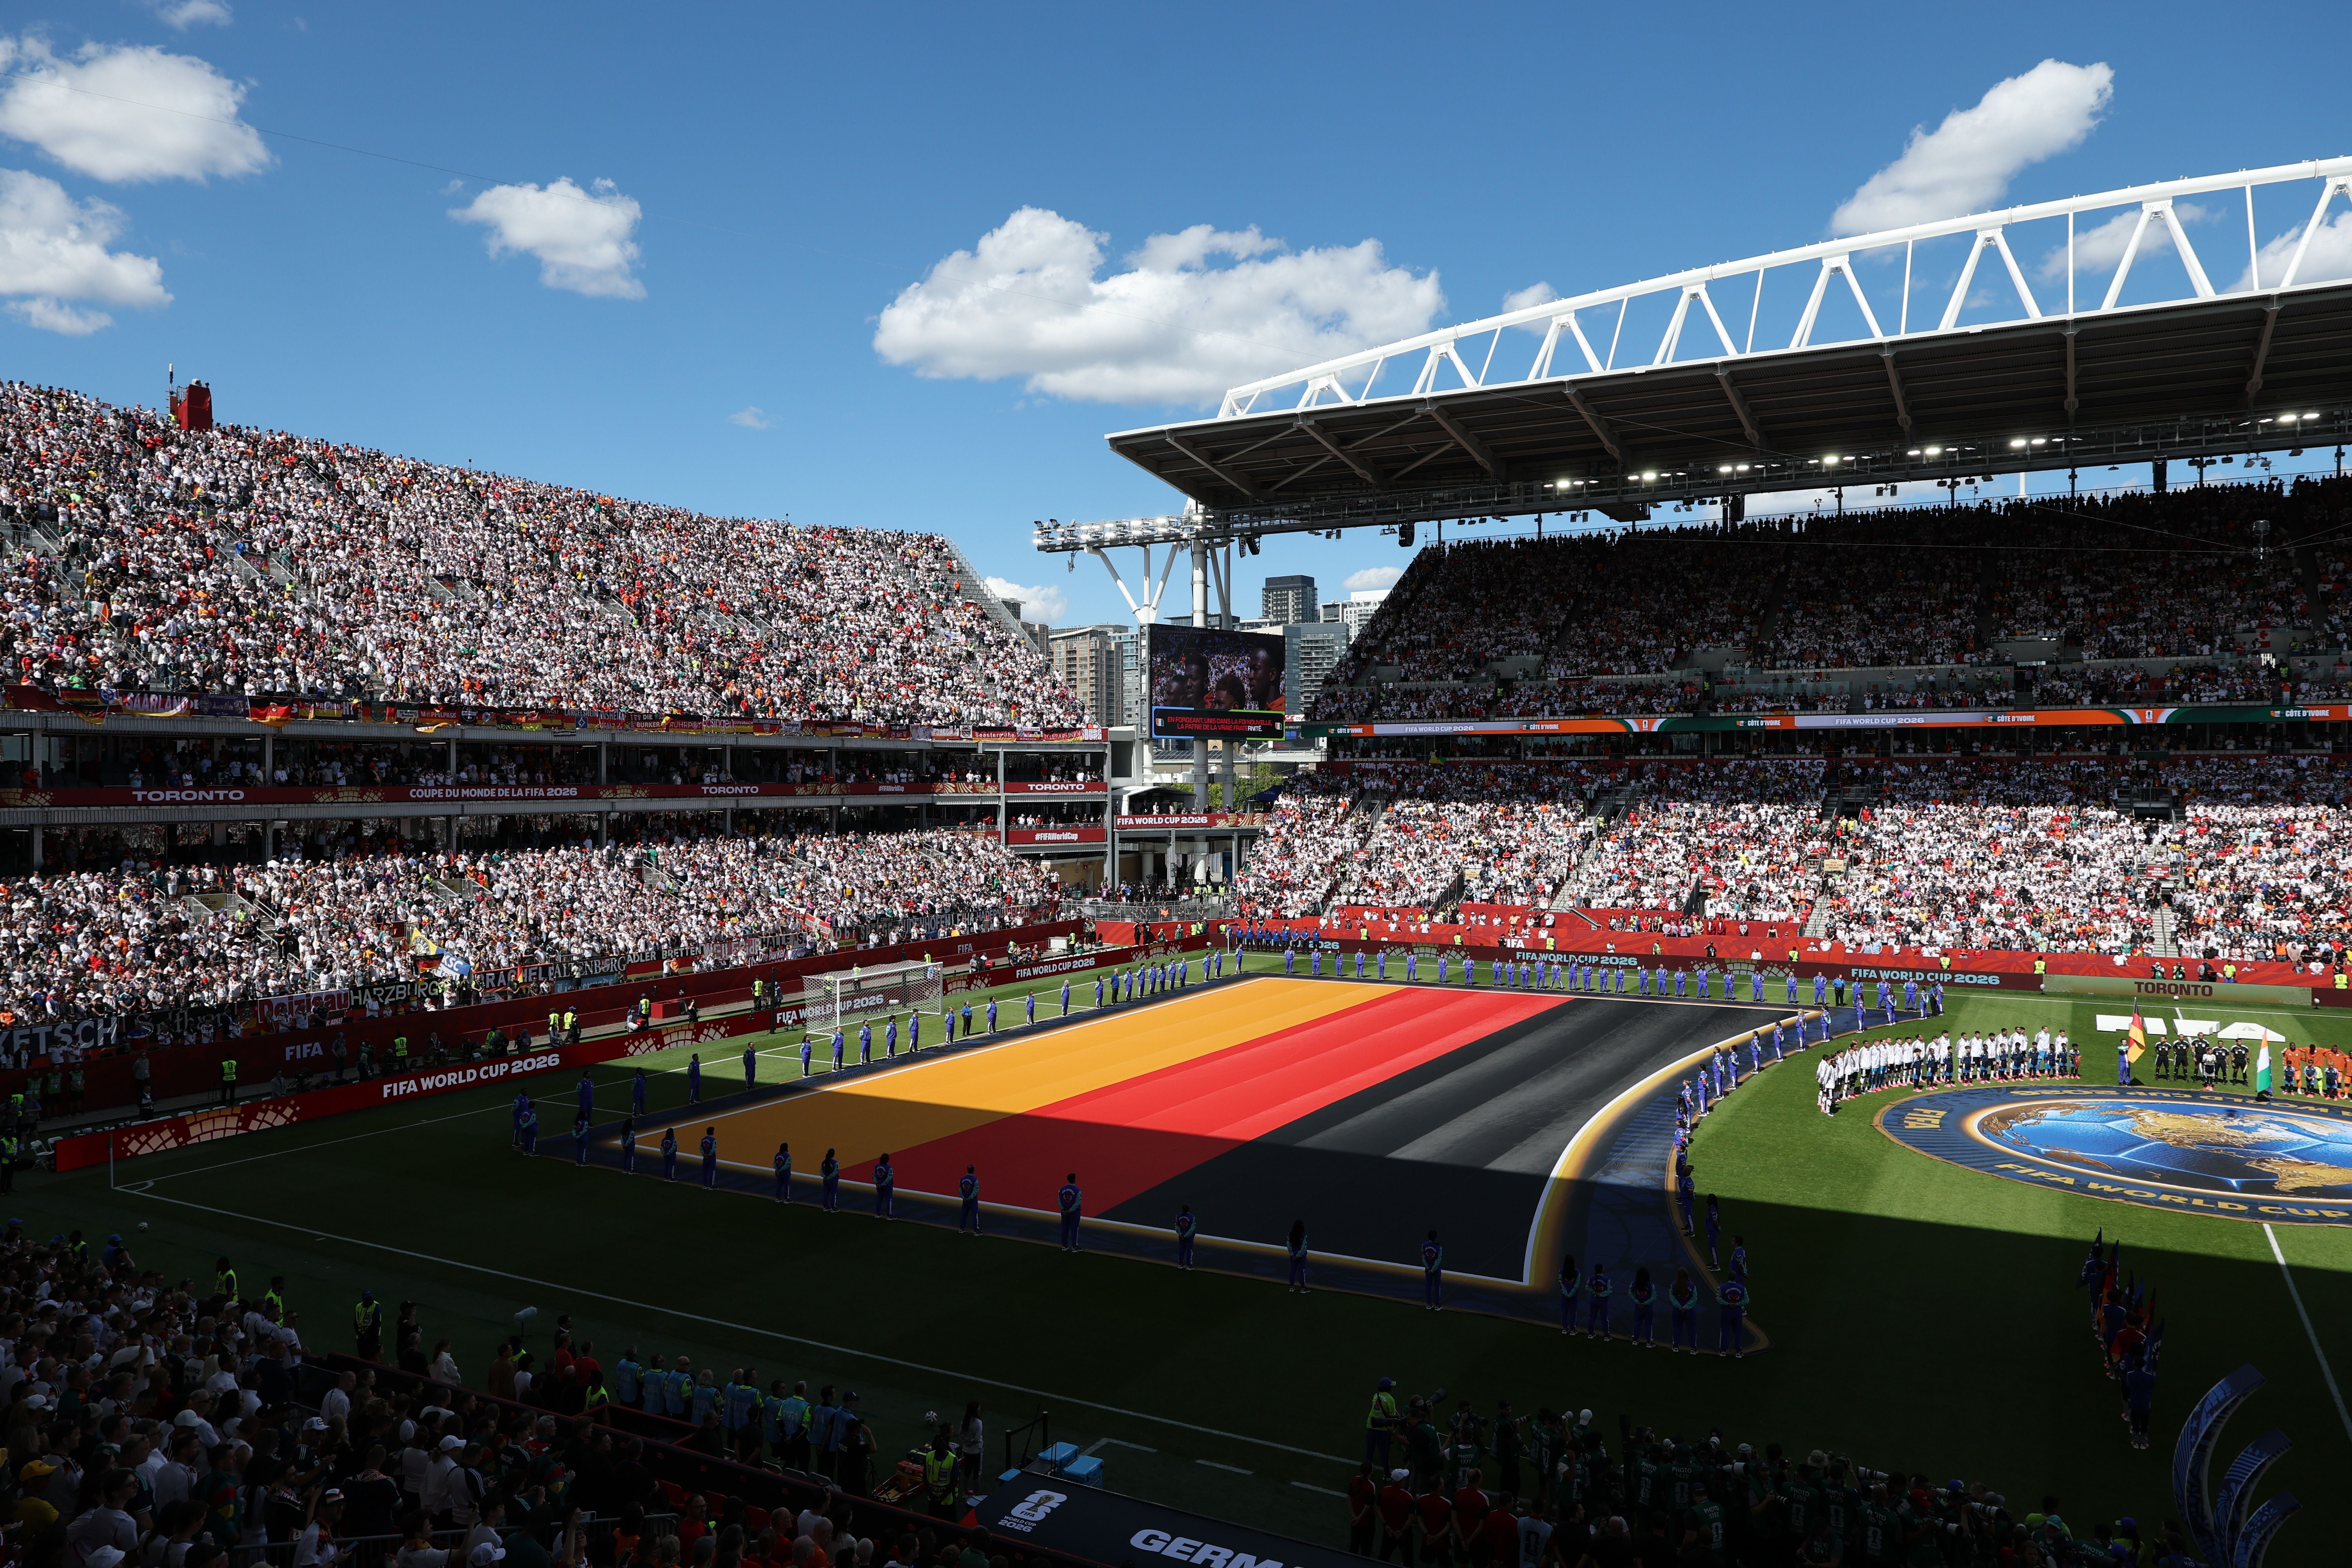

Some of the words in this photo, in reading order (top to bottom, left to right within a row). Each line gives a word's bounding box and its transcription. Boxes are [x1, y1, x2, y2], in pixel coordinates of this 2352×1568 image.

[126, 692, 189, 713] SAARLAND
[132, 790, 245, 801] TORONTO
[410, 789, 443, 798] COUPE
[445, 789, 459, 798] DU
[461, 788, 496, 797] MONDE
[498, 788, 510, 797] DE
[512, 788, 524, 797] LA
[525, 788, 544, 797] FIFA
[546, 787, 577, 796] 2026
[701, 786, 759, 794] TORONTO
[1035, 832, 1078, 841] #FIFAWorldCup
[627, 951, 657, 964] ADLER
[661, 945, 702, 960] BRETTEN
[957, 943, 974, 953] FIFA
[442, 953, 463, 971] KSC
[1516, 951, 1537, 961] FIFA
[1539, 953, 1577, 964] WORLD
[1578, 955, 1599, 964] CUP
[1600, 956, 1638, 966] 2026
[1016, 968, 1032, 978] FIFA
[1032, 964, 1057, 976] WORLD
[1058, 961, 1072, 971] CUP
[1072, 957, 1095, 969] 2026
[1851, 968, 1877, 978] FIFA
[1879, 969, 1925, 981] WORLD
[1927, 973, 1953, 982] CUP
[1954, 973, 2000, 985] 2026
[351, 980, 439, 1005] HARZBURG
[2134, 981, 2214, 997] TORONTO
[777, 1010, 798, 1024] FIFA
[853, 994, 884, 1009] 2026
[285, 1042, 323, 1061] FIFA
[383, 1080, 418, 1098] FIFA
[420, 1069, 477, 1090] WORLD
[479, 1063, 509, 1080] CUP
[511, 1053, 560, 1074] 2026
[1904, 1108, 1948, 1129] FIFA
[1994, 1163, 2075, 1186] FIFA
[2088, 1181, 2250, 1211] WORLD
[2258, 1205, 2351, 1218] CUP
[838, 1442, 848, 1453] POLICE
[1641, 1461, 1657, 1471] PHOTO
[1790, 1486, 1810, 1497] PHOTO
[1704, 1506, 1720, 1514] PHOTO
[997, 1519, 1033, 1533] 2026
[1004, 1515, 1024, 1524] WORLD
[1130, 1529, 1305, 1568] GERM
[2082, 1543, 2104, 1557] PHOTO
